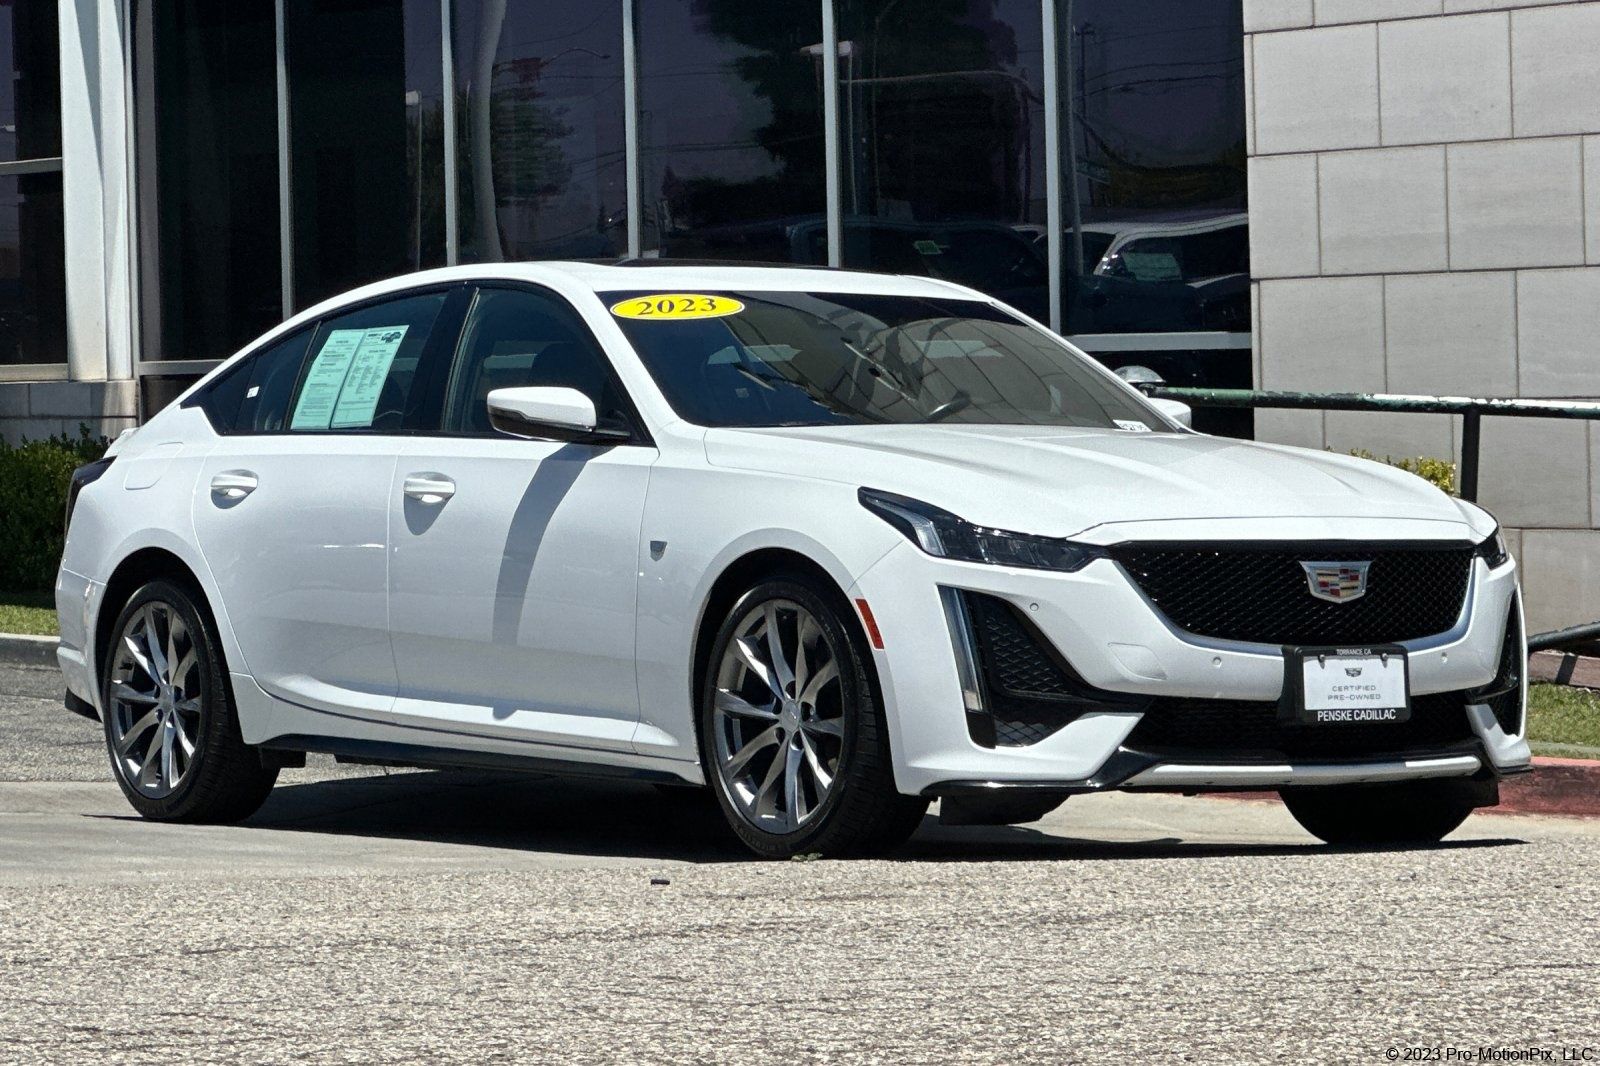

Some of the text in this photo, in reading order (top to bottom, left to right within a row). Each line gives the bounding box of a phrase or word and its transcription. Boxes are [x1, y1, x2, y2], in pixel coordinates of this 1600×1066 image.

[636, 298, 717, 316] 2023
[1317, 709, 1396, 721] PENSKE CADILLAC
